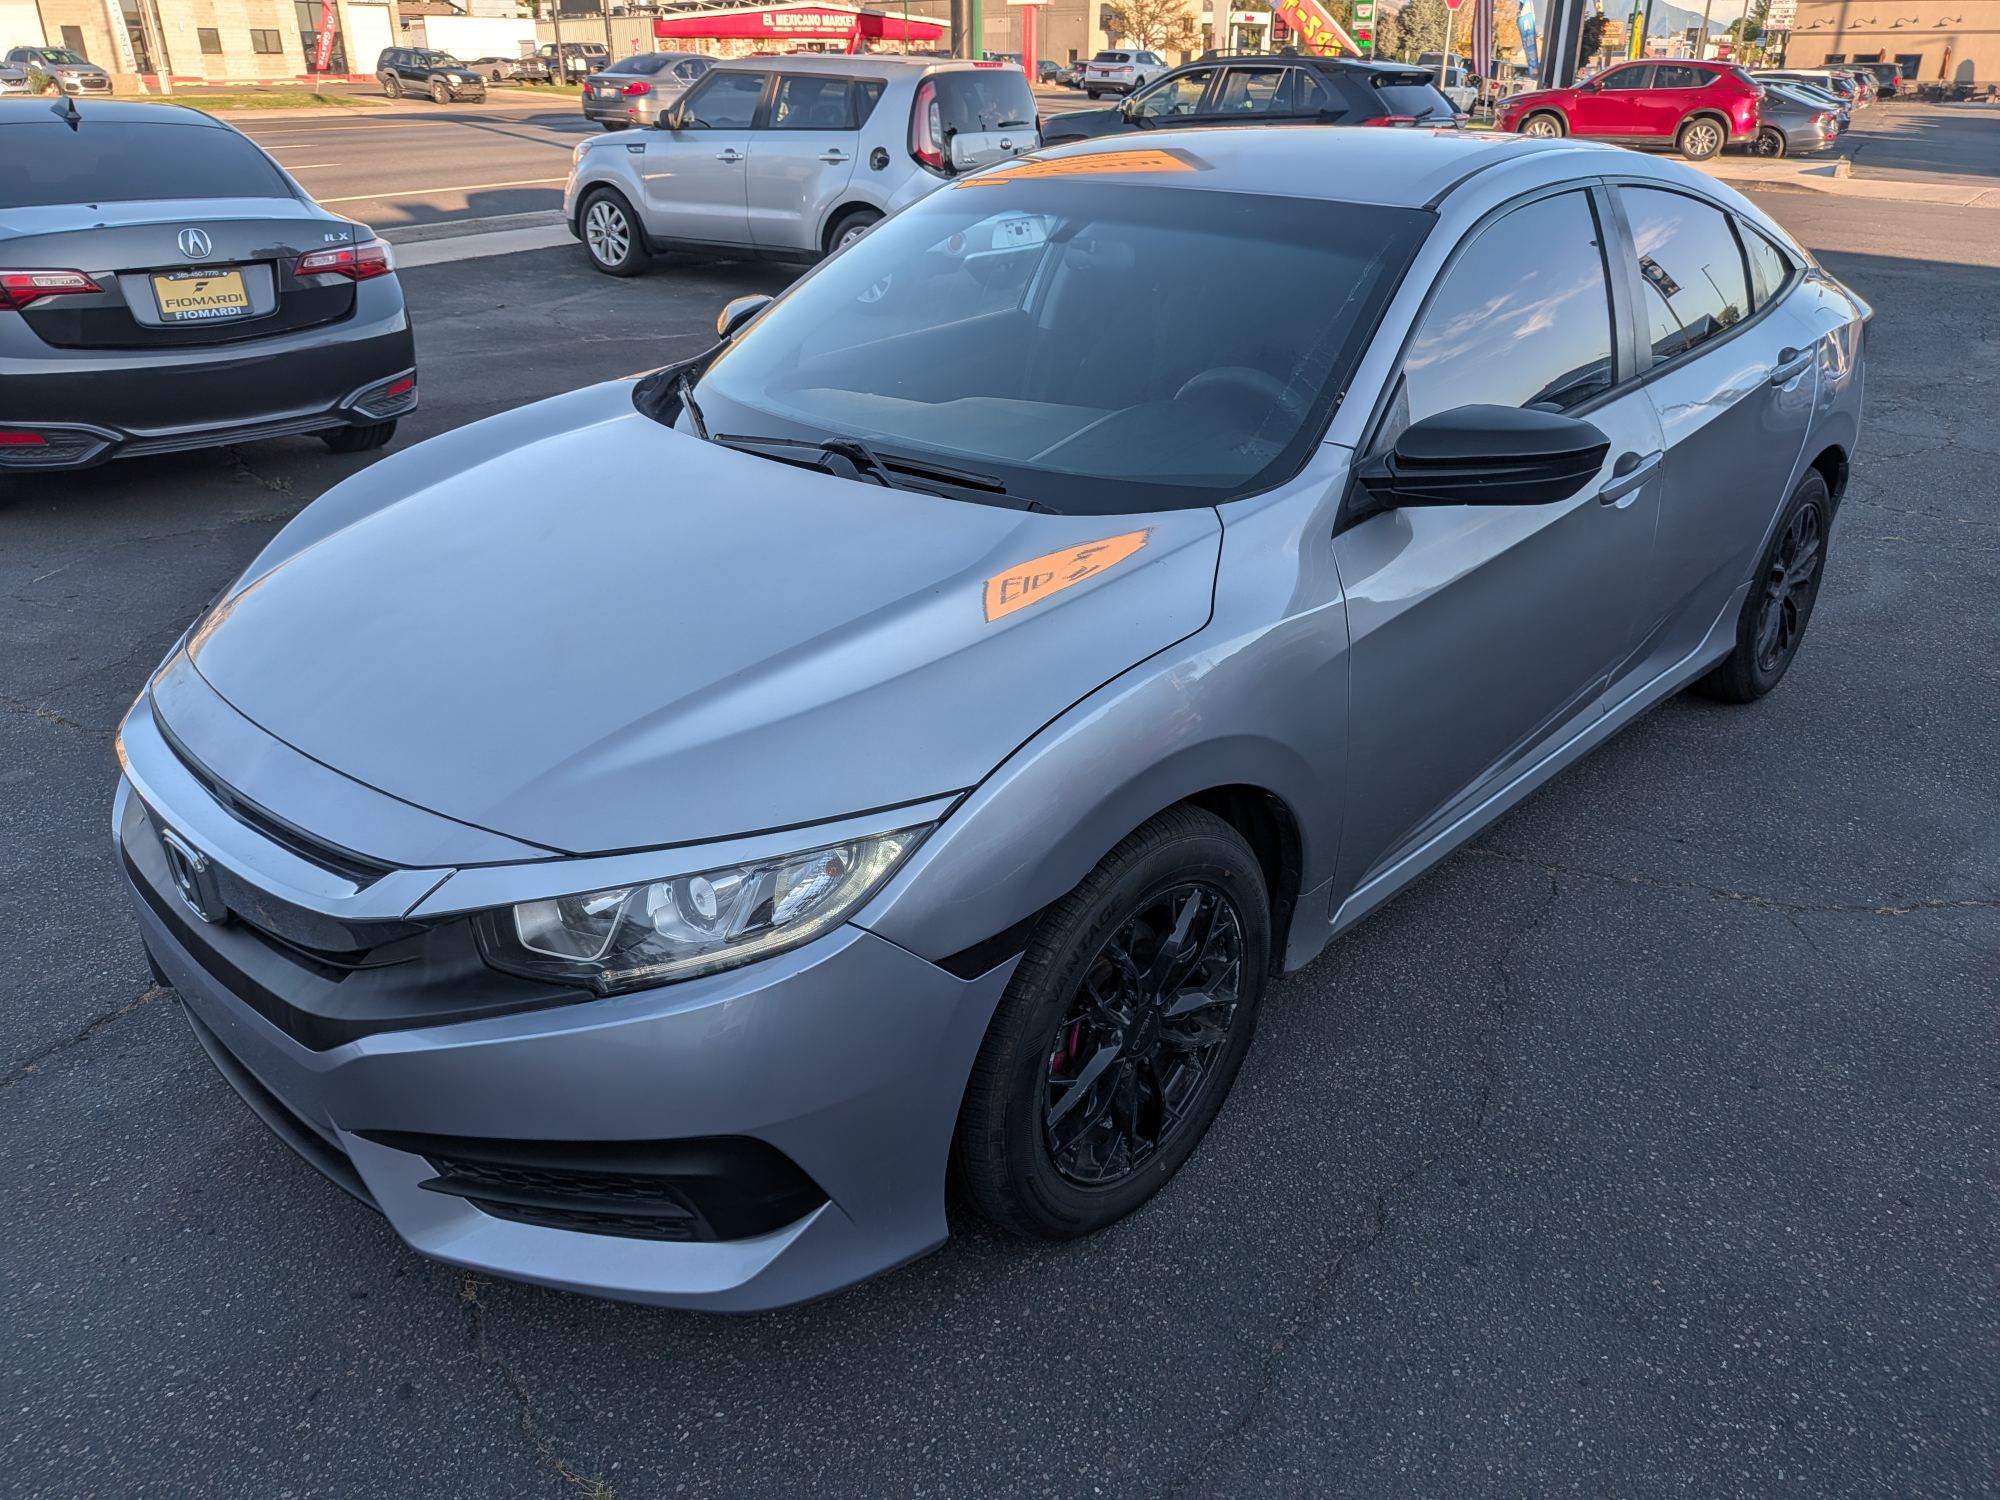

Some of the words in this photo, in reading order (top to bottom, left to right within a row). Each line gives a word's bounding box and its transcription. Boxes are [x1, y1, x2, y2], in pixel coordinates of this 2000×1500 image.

[762, 13, 774, 26] EL
[775, 14, 821, 26] MEXICANO
[822, 15, 857, 27] MARKET
[324, 232, 349, 242] ILX
[165, 293, 244, 308] FIOMARDI
[175, 307, 242, 320] FIOMARDI
